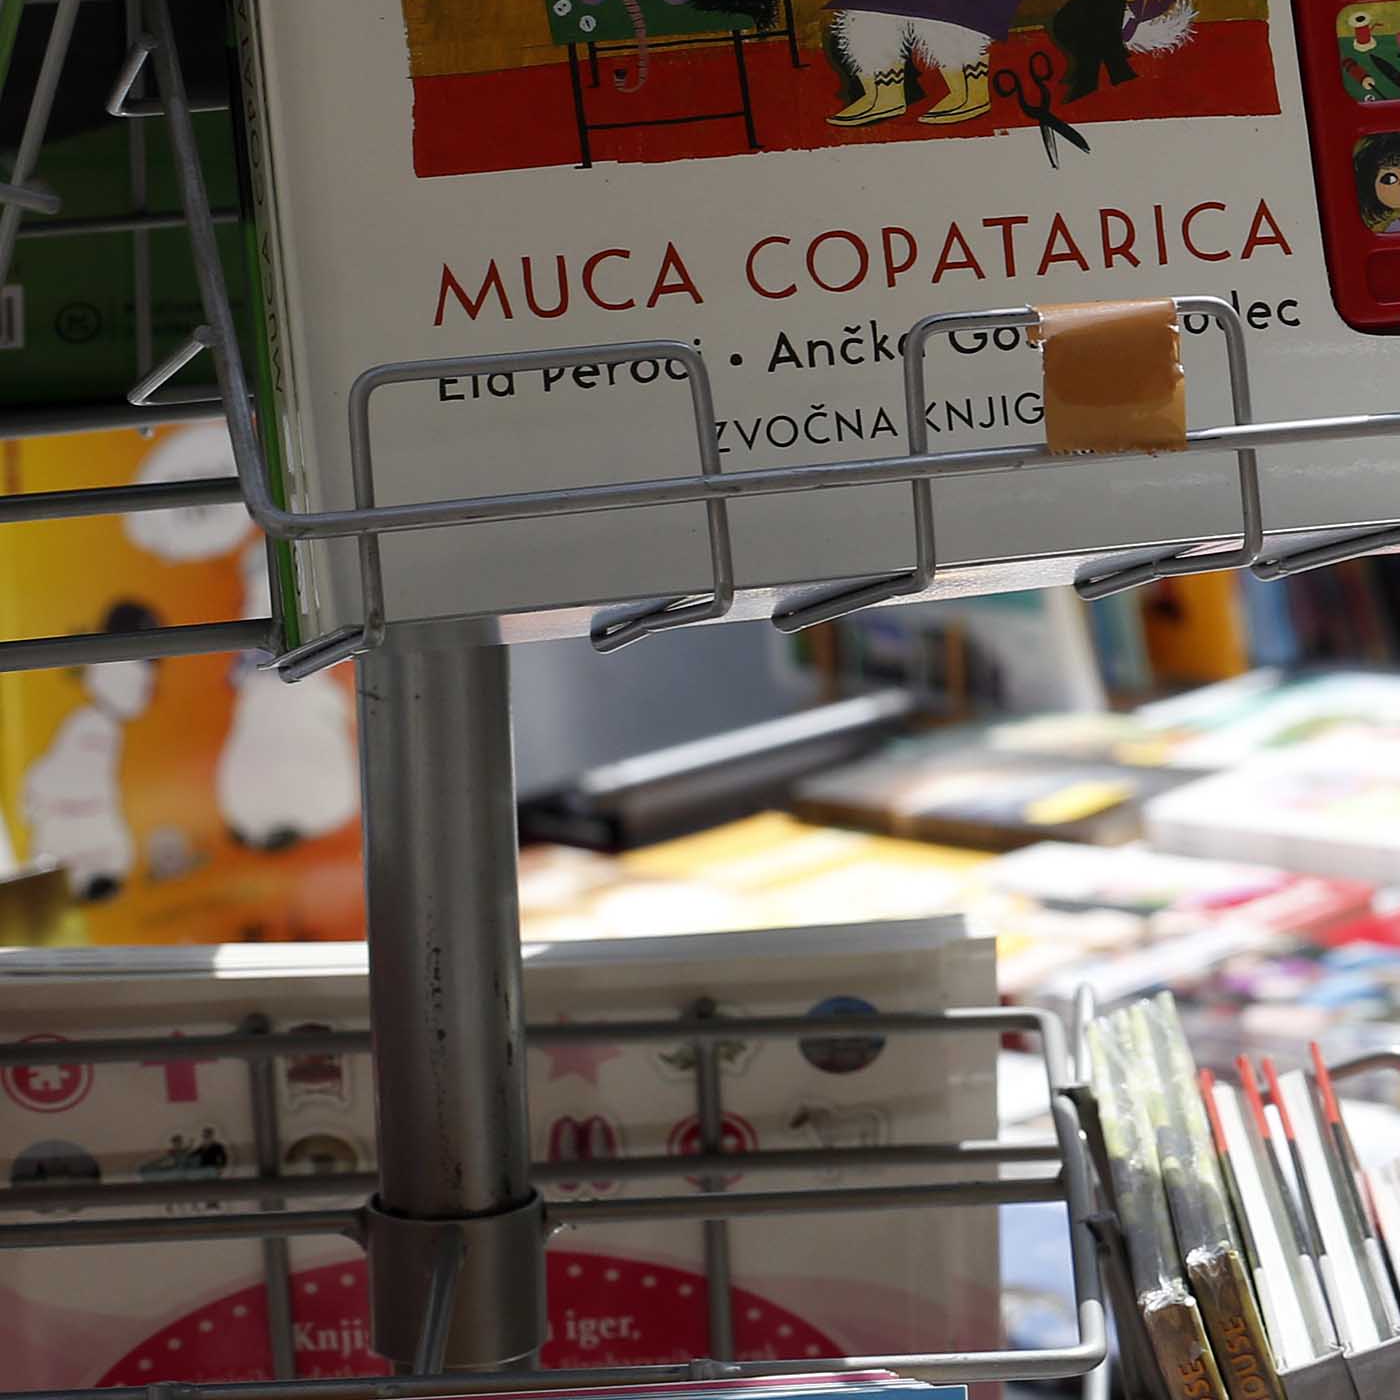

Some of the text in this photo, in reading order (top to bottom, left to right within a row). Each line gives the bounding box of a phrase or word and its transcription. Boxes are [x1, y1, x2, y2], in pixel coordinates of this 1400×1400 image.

[433, 198, 1293, 327] MUCA COPATARICA
[714, 403, 898, 453] ZVOČNA
[293, 1318, 371, 1357] Knji
